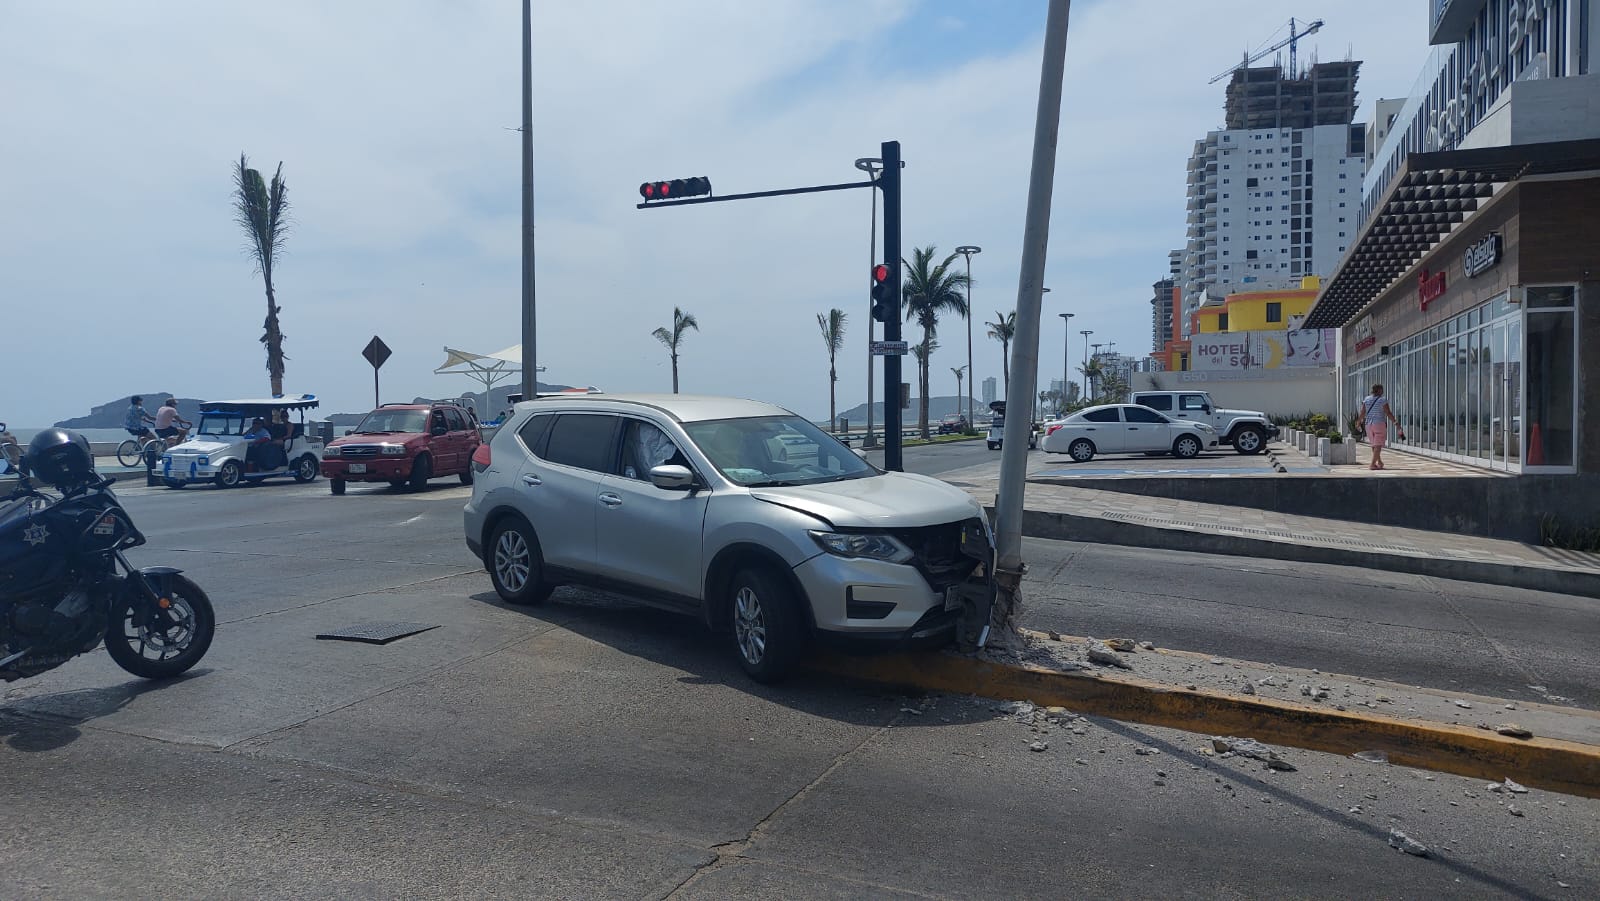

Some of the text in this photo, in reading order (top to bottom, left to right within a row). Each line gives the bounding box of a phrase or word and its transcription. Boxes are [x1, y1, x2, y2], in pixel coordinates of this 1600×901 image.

[1508, 0, 1554, 55] BA
[1198, 343, 1249, 356] HOTEL
[1211, 356, 1261, 367] del SOL
[1182, 372, 1208, 382] 650
